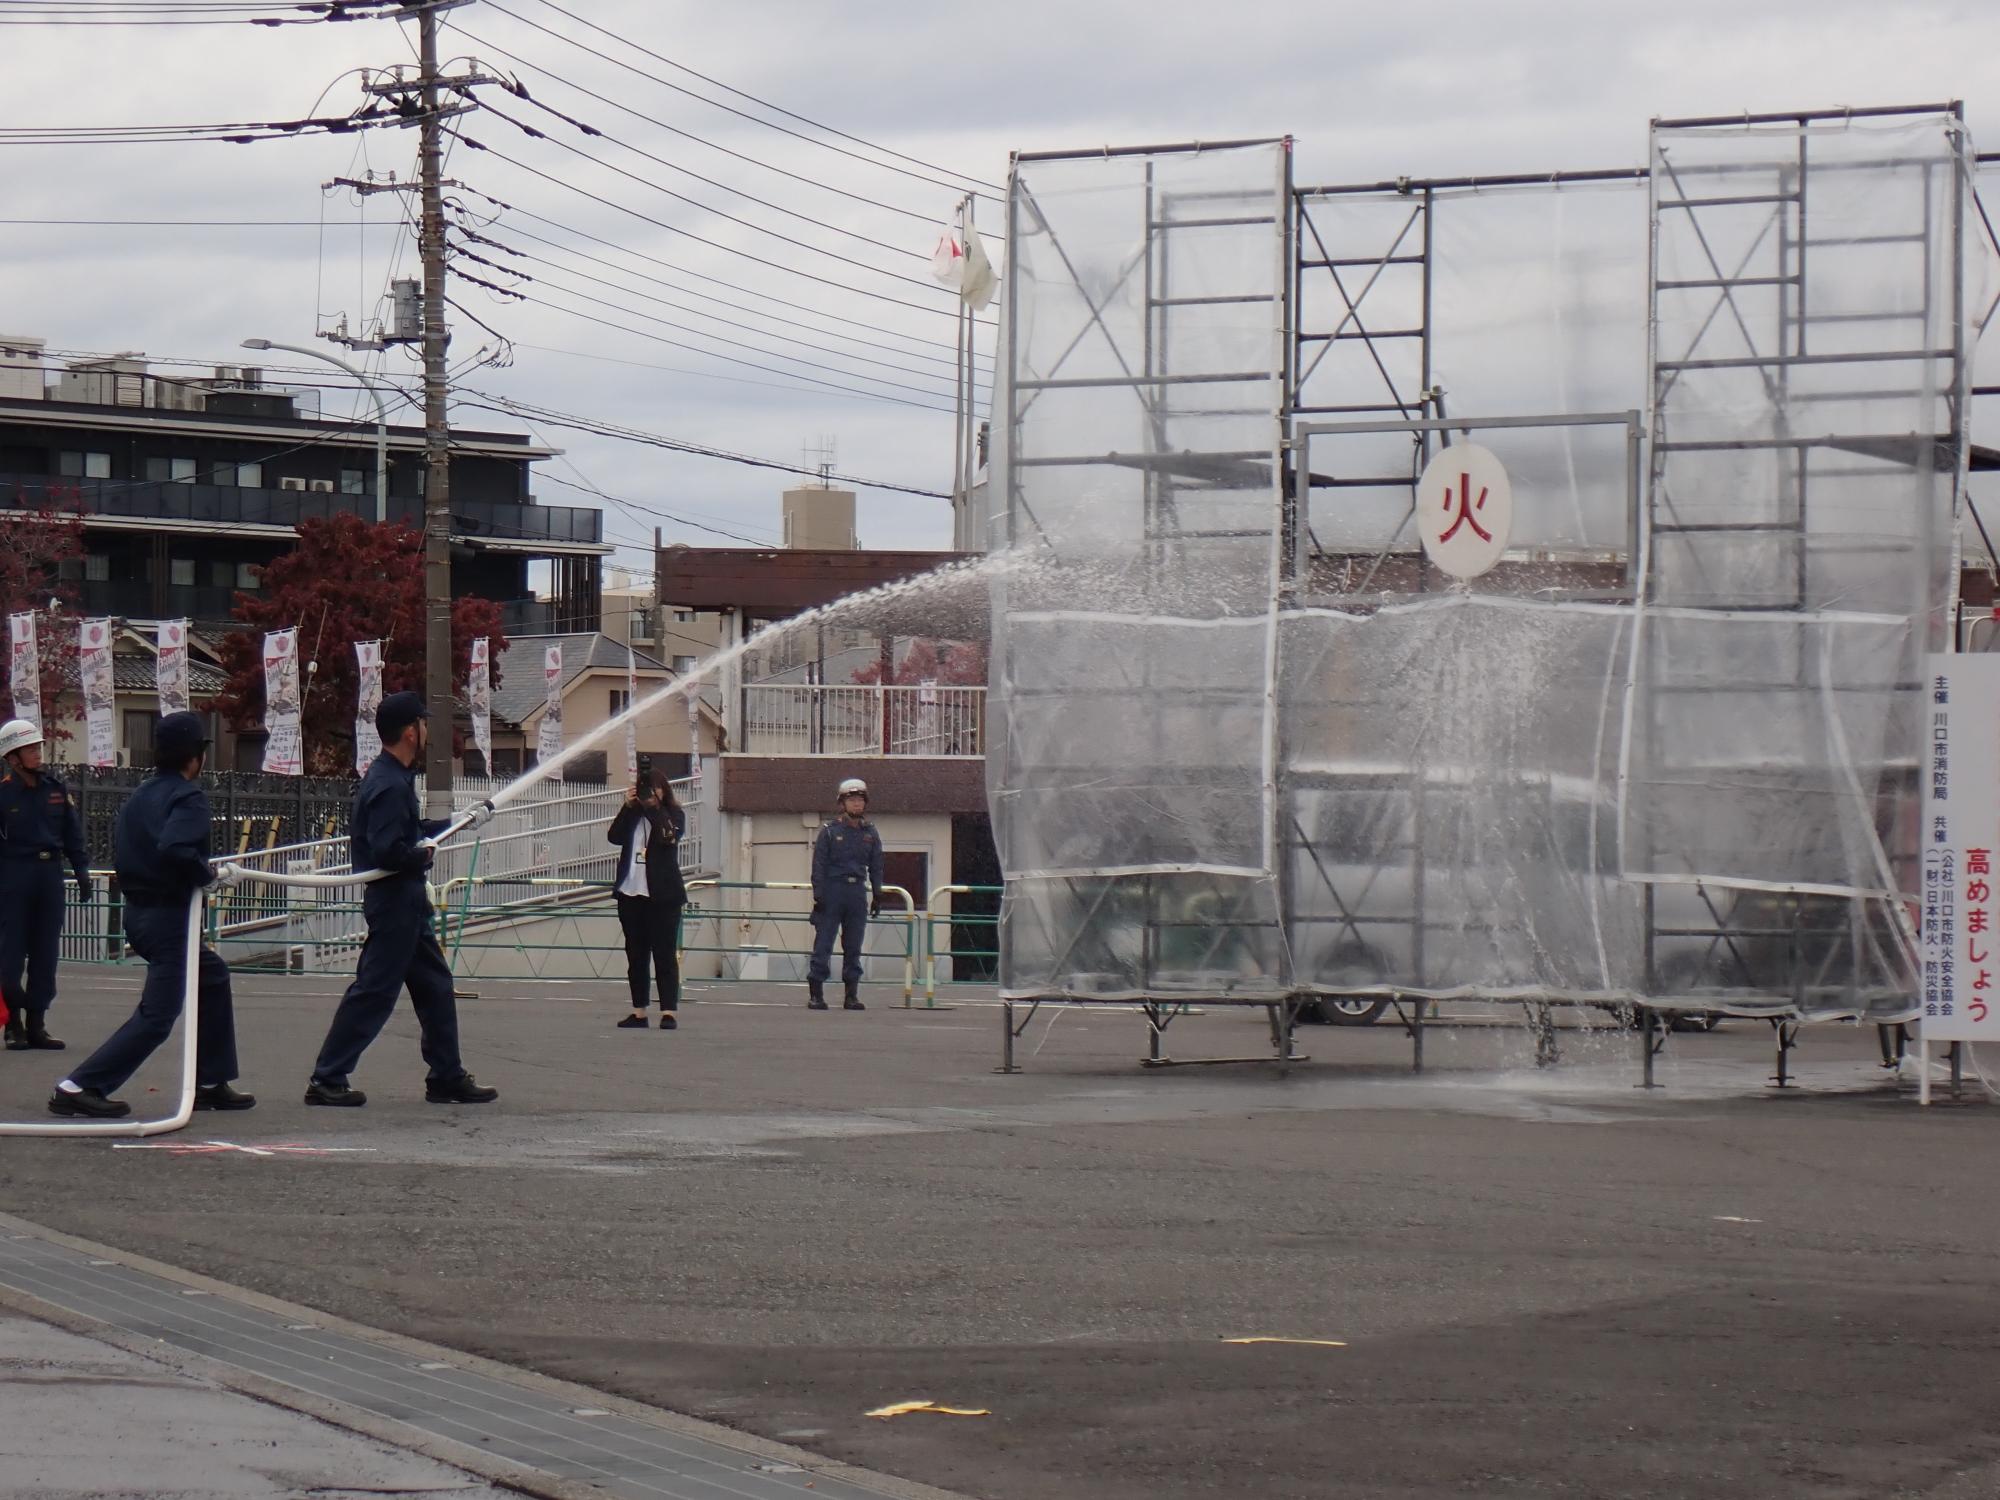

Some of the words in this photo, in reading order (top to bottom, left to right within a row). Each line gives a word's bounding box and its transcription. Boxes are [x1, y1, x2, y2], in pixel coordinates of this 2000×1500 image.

[1439, 472, 1492, 544] 火
[1933, 675, 1949, 705] 主催
[1933, 712, 1949, 801] 川口市消防局
[1933, 815, 1949, 844] 共催
[1966, 847, 1992, 1022] 高めましょう
